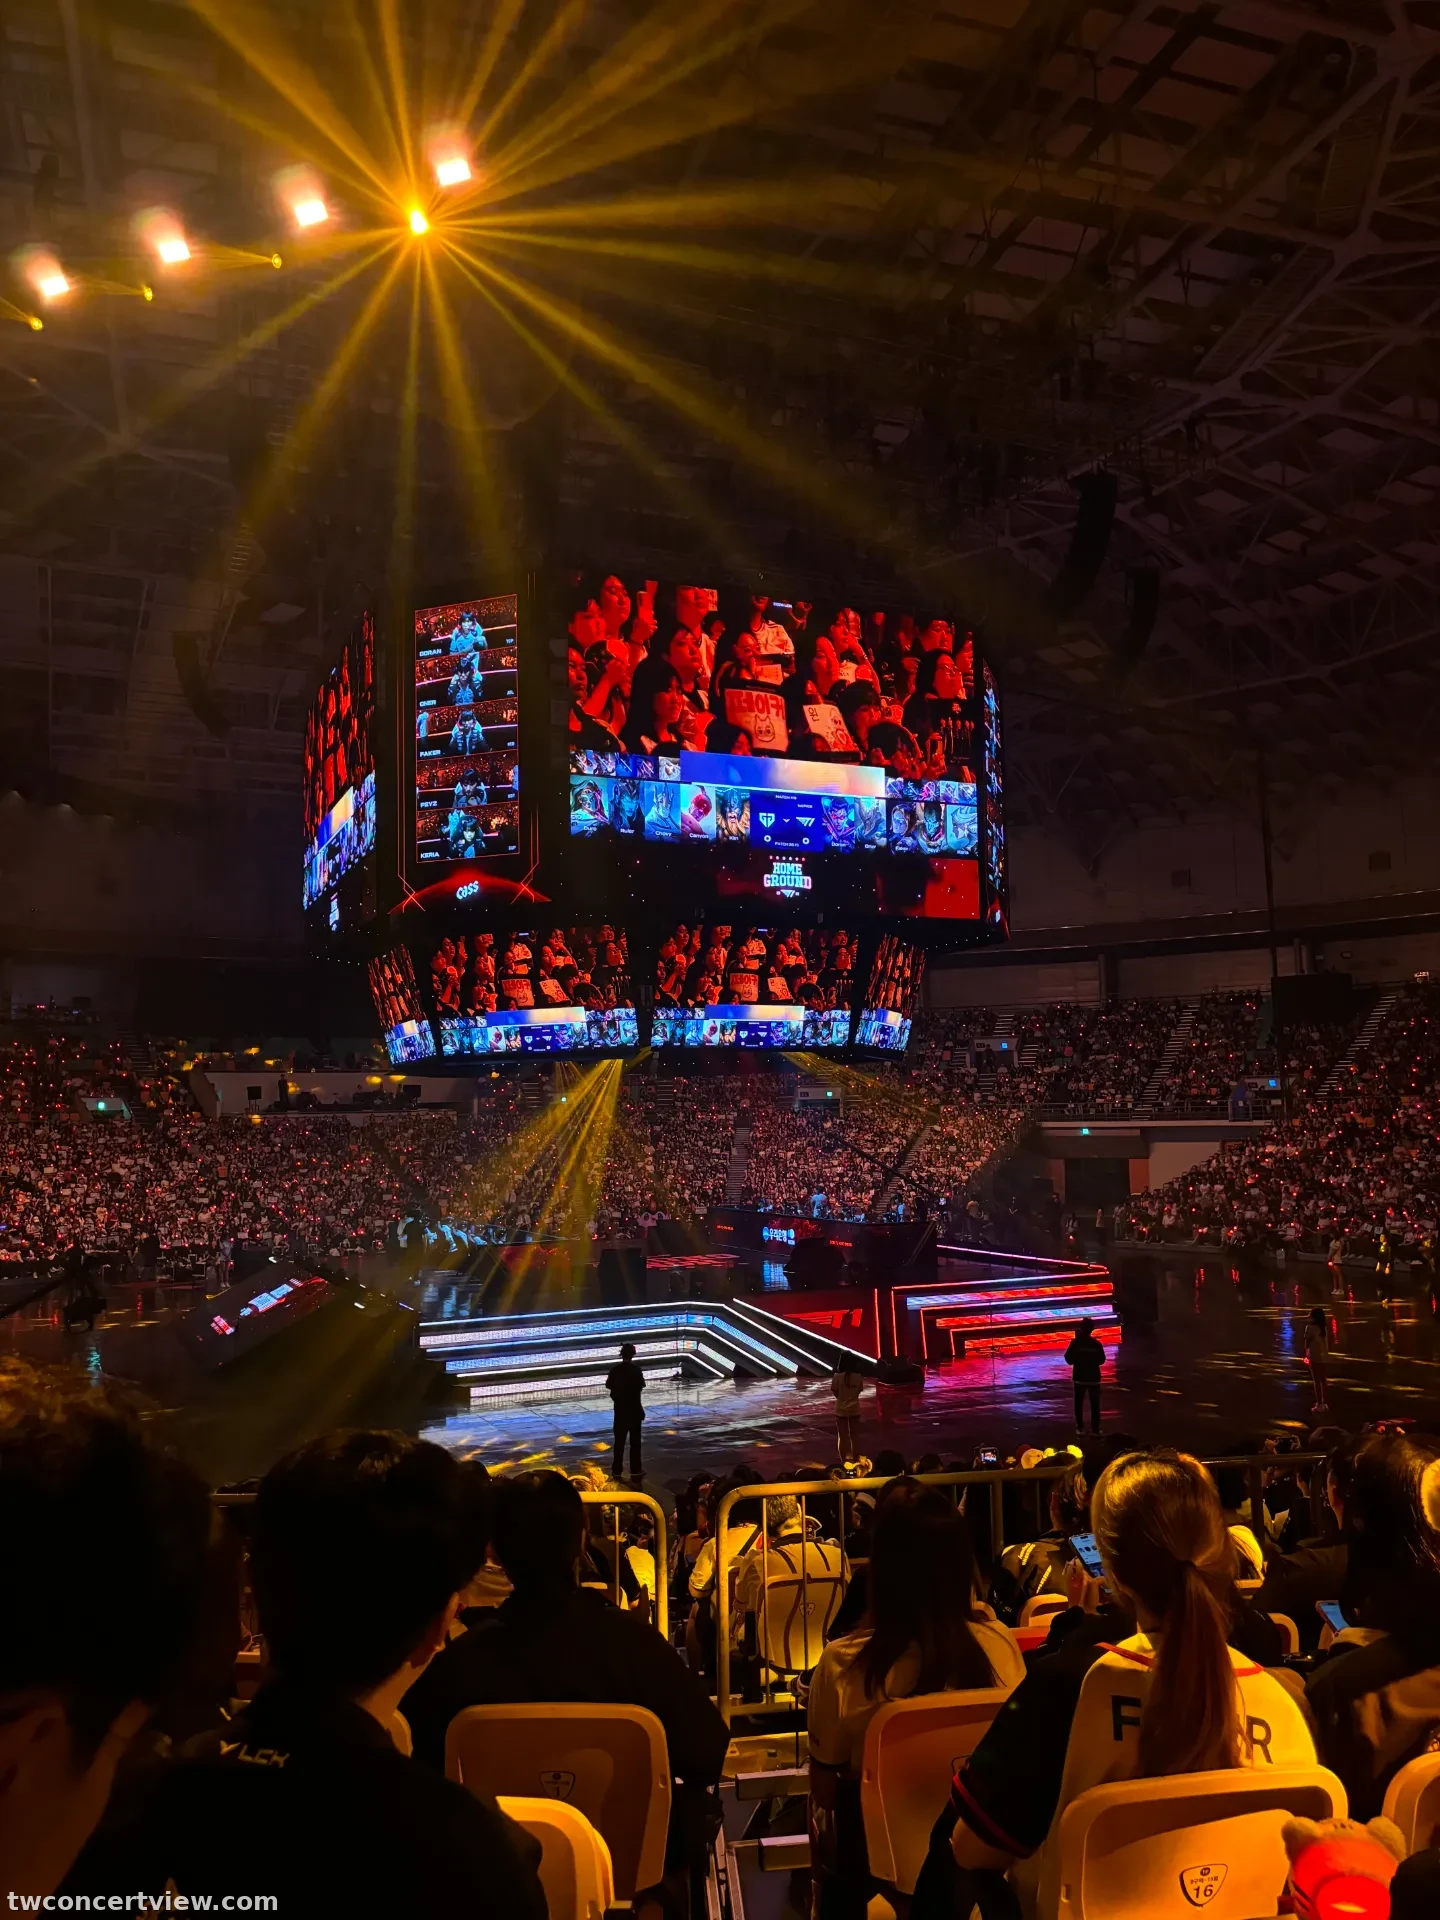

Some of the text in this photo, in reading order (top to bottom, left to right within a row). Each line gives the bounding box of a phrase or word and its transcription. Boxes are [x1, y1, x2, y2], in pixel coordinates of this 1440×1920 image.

[419, 649, 442, 657] DORAN
[420, 749, 441, 758] FAKER
[420, 800, 438, 808] PEYZ
[420, 851, 440, 859] KERIA
[772, 862, 803, 876] HOME
[763, 874, 812, 890] GROUND
[782, 1308, 863, 1329] T1
[1193, 1884, 1214, 1899] 16
